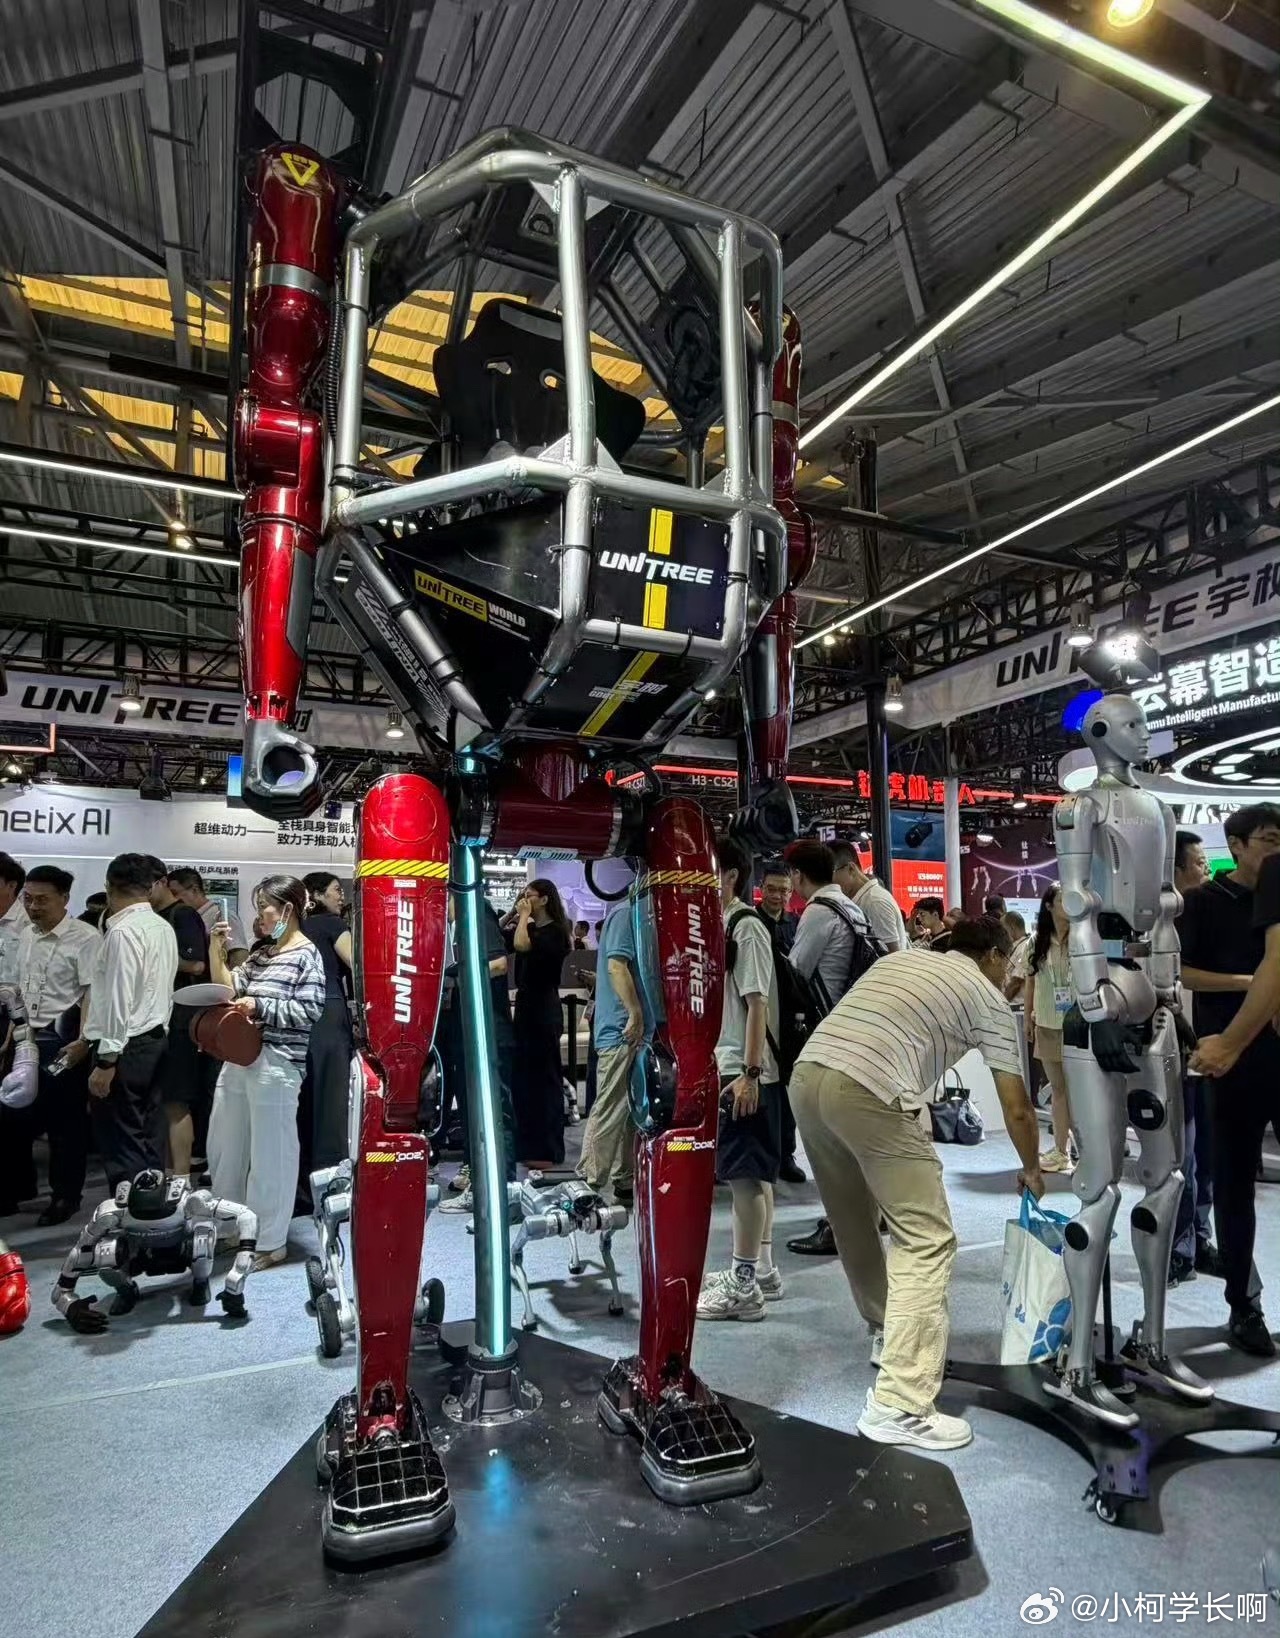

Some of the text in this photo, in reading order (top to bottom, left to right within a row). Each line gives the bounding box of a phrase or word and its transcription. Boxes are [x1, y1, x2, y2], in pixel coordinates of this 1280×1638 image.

[600, 551, 714, 585] UNITREE
[417, 576, 484, 615] UNITREE
[488, 602, 526, 627] WORLD
[1126, 637, 1280, 714] 云幕智造
[1166, 704, 1218, 726] Intelligent
[1219, 691, 1280, 714] Manufactu
[691, 774, 738, 788] H3-C521
[82, 808, 111, 835] AI
[391, 900, 417, 1023] UNITREE
[686, 903, 705, 1015] UNITREE
